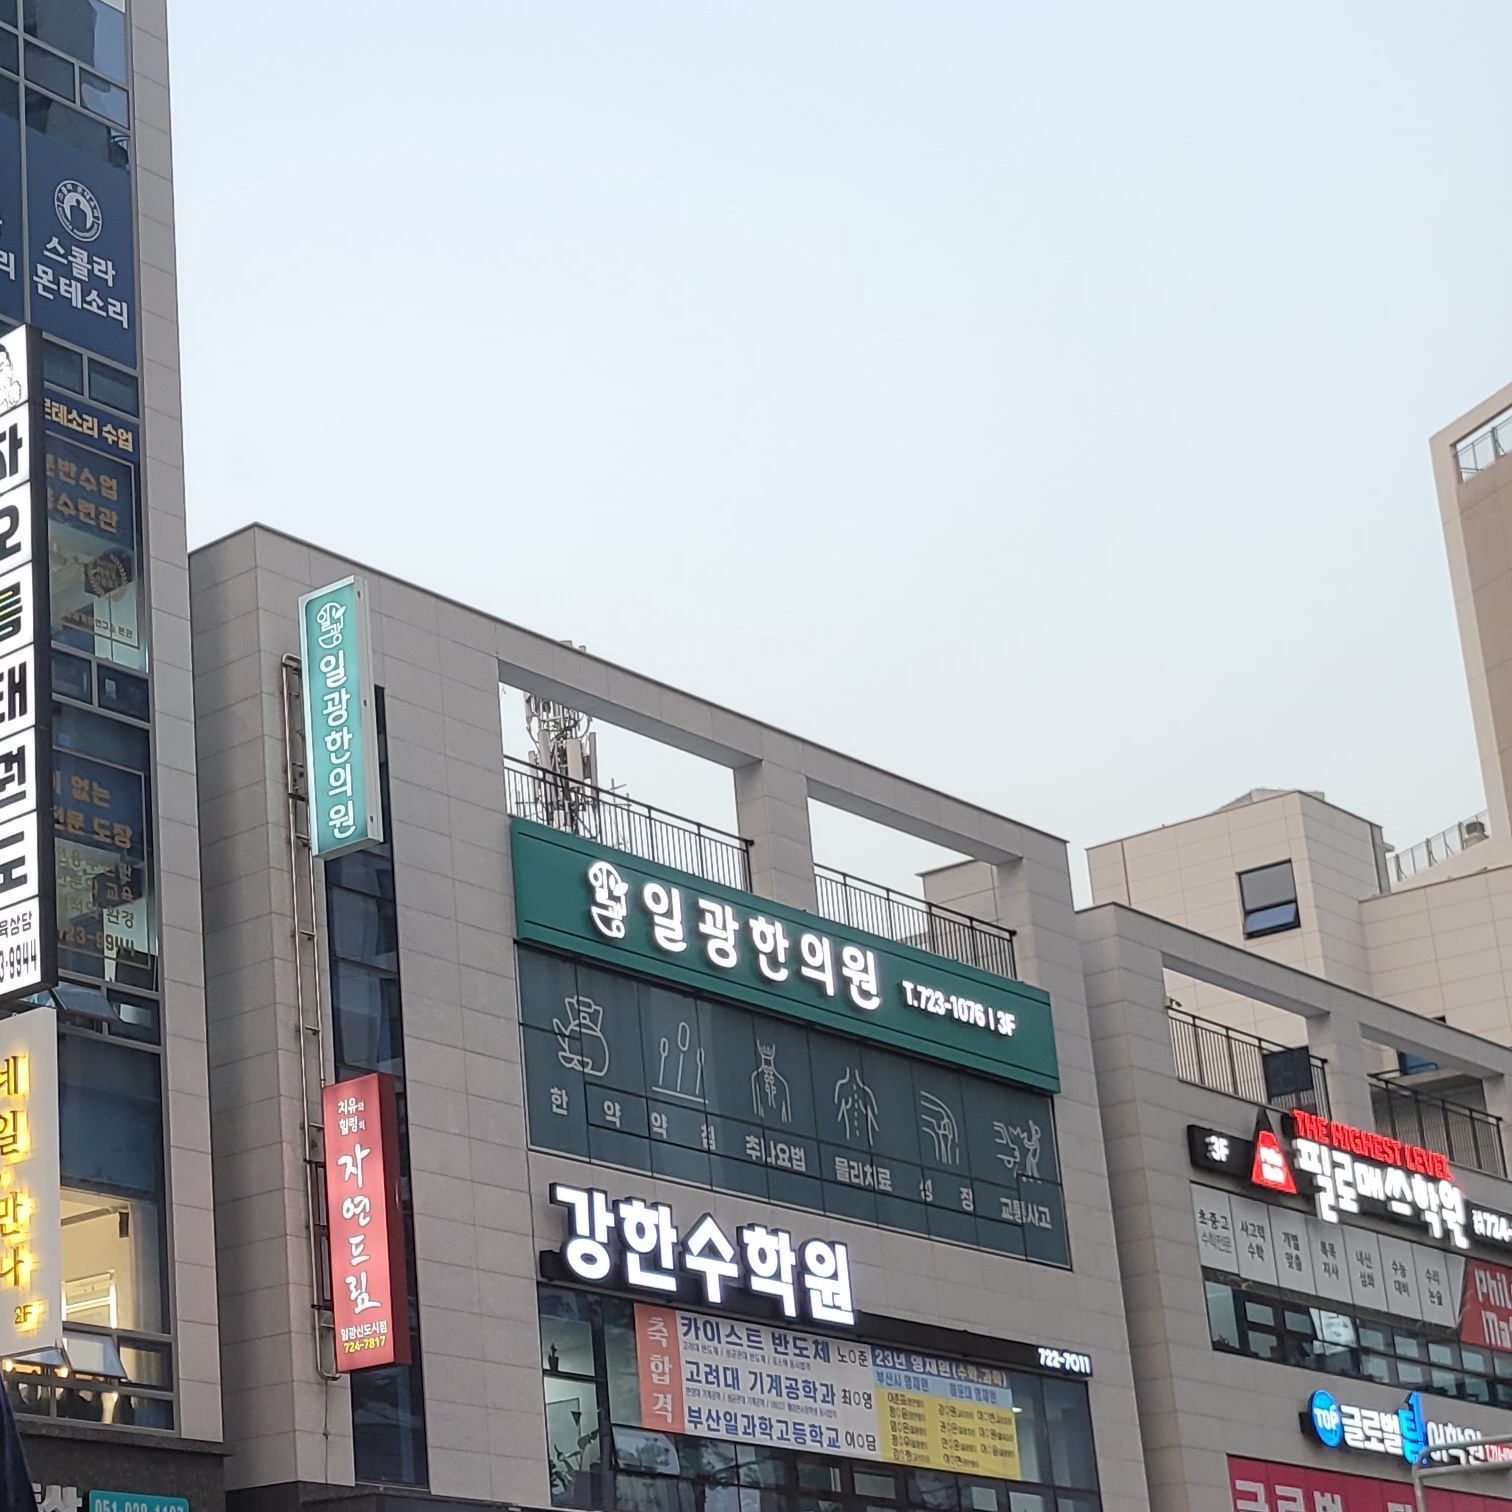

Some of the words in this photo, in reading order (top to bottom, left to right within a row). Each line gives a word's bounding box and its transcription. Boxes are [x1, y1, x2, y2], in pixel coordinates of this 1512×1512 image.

[43, 236, 116, 288] 스콜라
[33, 263, 129, 330] 몬테소리
[102, 421, 134, 453] 수업
[319, 649, 357, 840] 일광한의원
[93, 816, 134, 850] 도장
[642, 887, 882, 1011] 일광한의원
[1292, 1109, 1330, 1145] THE
[1330, 1121, 1404, 1167] HIGHEST
[1404, 1144, 1456, 1182] LEVEL
[337, 1143, 383, 1316] 자연드림
[999, 1197, 1053, 1230] 교통사고
[1199, 1208, 1230, 1231] 초중고
[553, 1185, 856, 1326] 강한수학원
[679, 1315, 766, 1351] 카이스트
[770, 1331, 832, 1364] 반도체
[875, 1349, 907, 1371] 23년
[684, 1359, 741, 1391] 고려대
[748, 1370, 837, 1407] 기계공학과
[686, 1405, 841, 1450] 부산일과학고등학교
[1313, 1407, 1340, 1430] TOP
